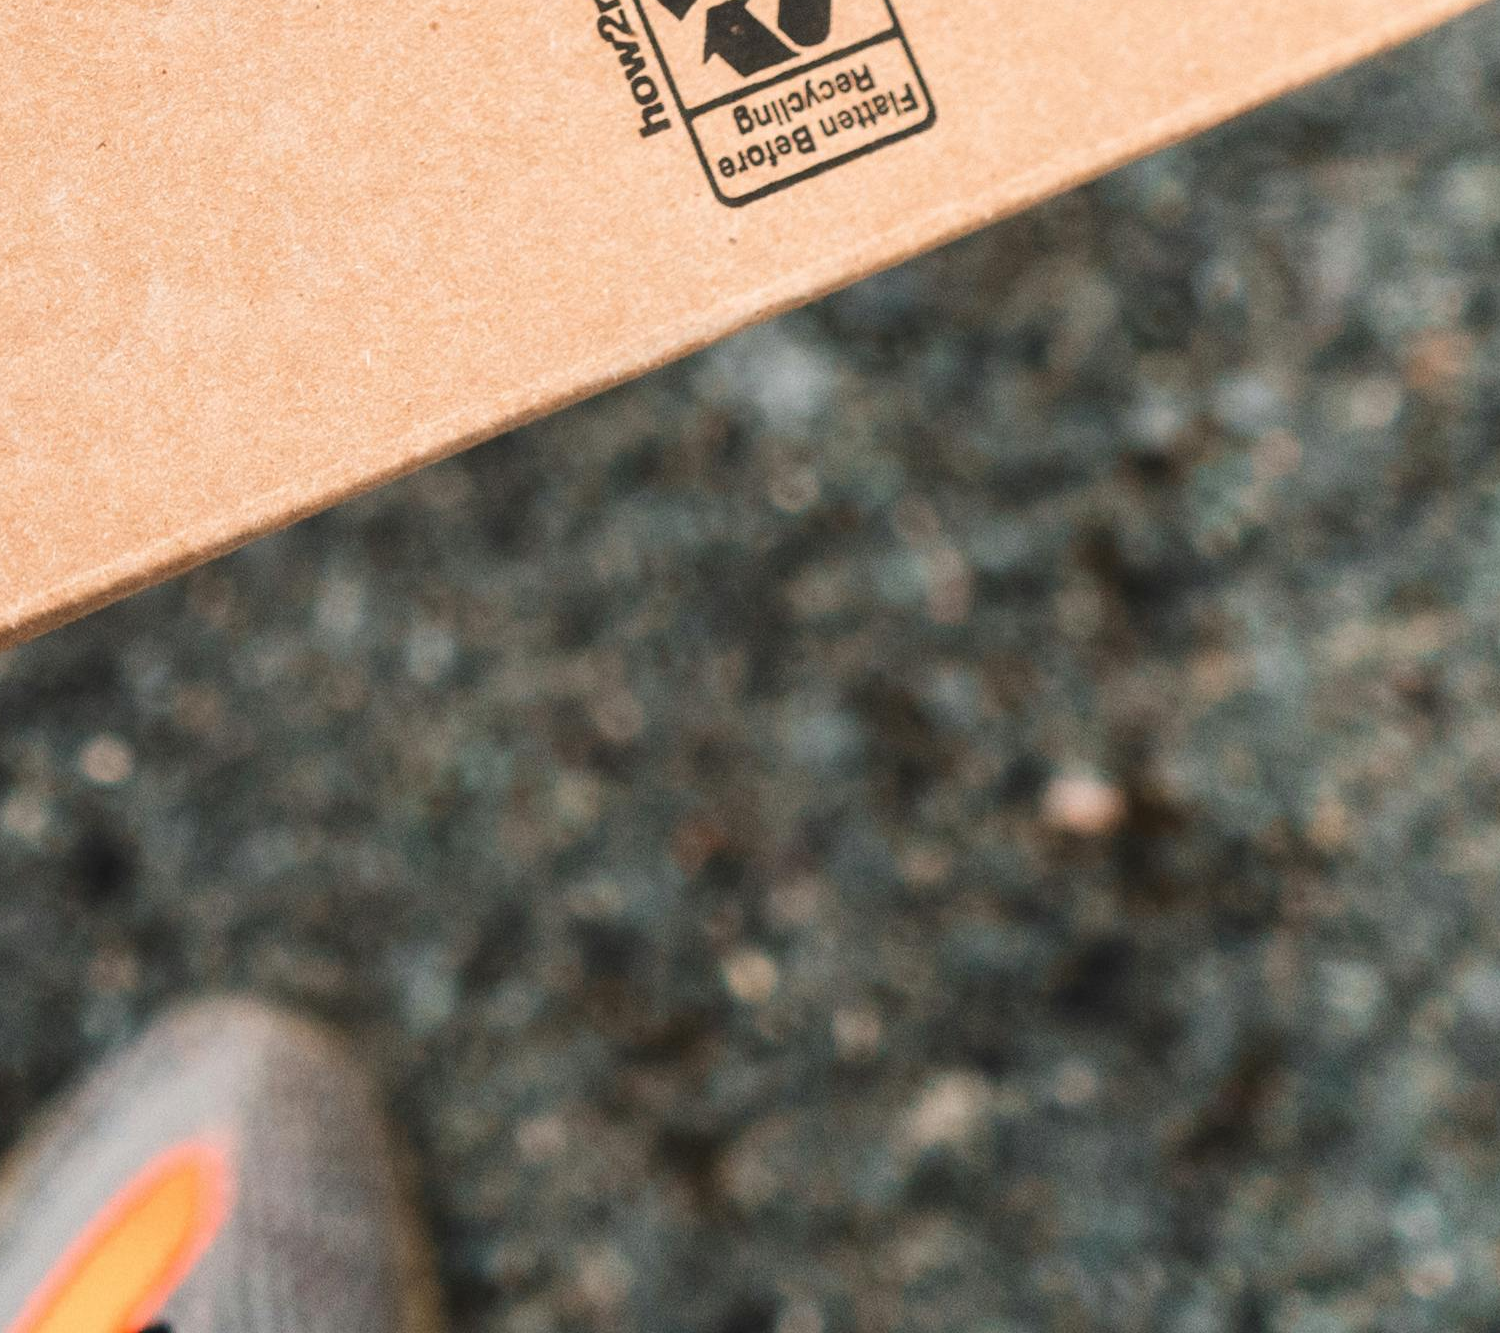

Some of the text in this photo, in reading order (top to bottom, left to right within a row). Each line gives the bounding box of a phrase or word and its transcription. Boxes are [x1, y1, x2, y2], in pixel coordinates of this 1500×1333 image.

[718, 81, 919, 179] Flatten Before
[732, 63, 875, 134] Recycling
